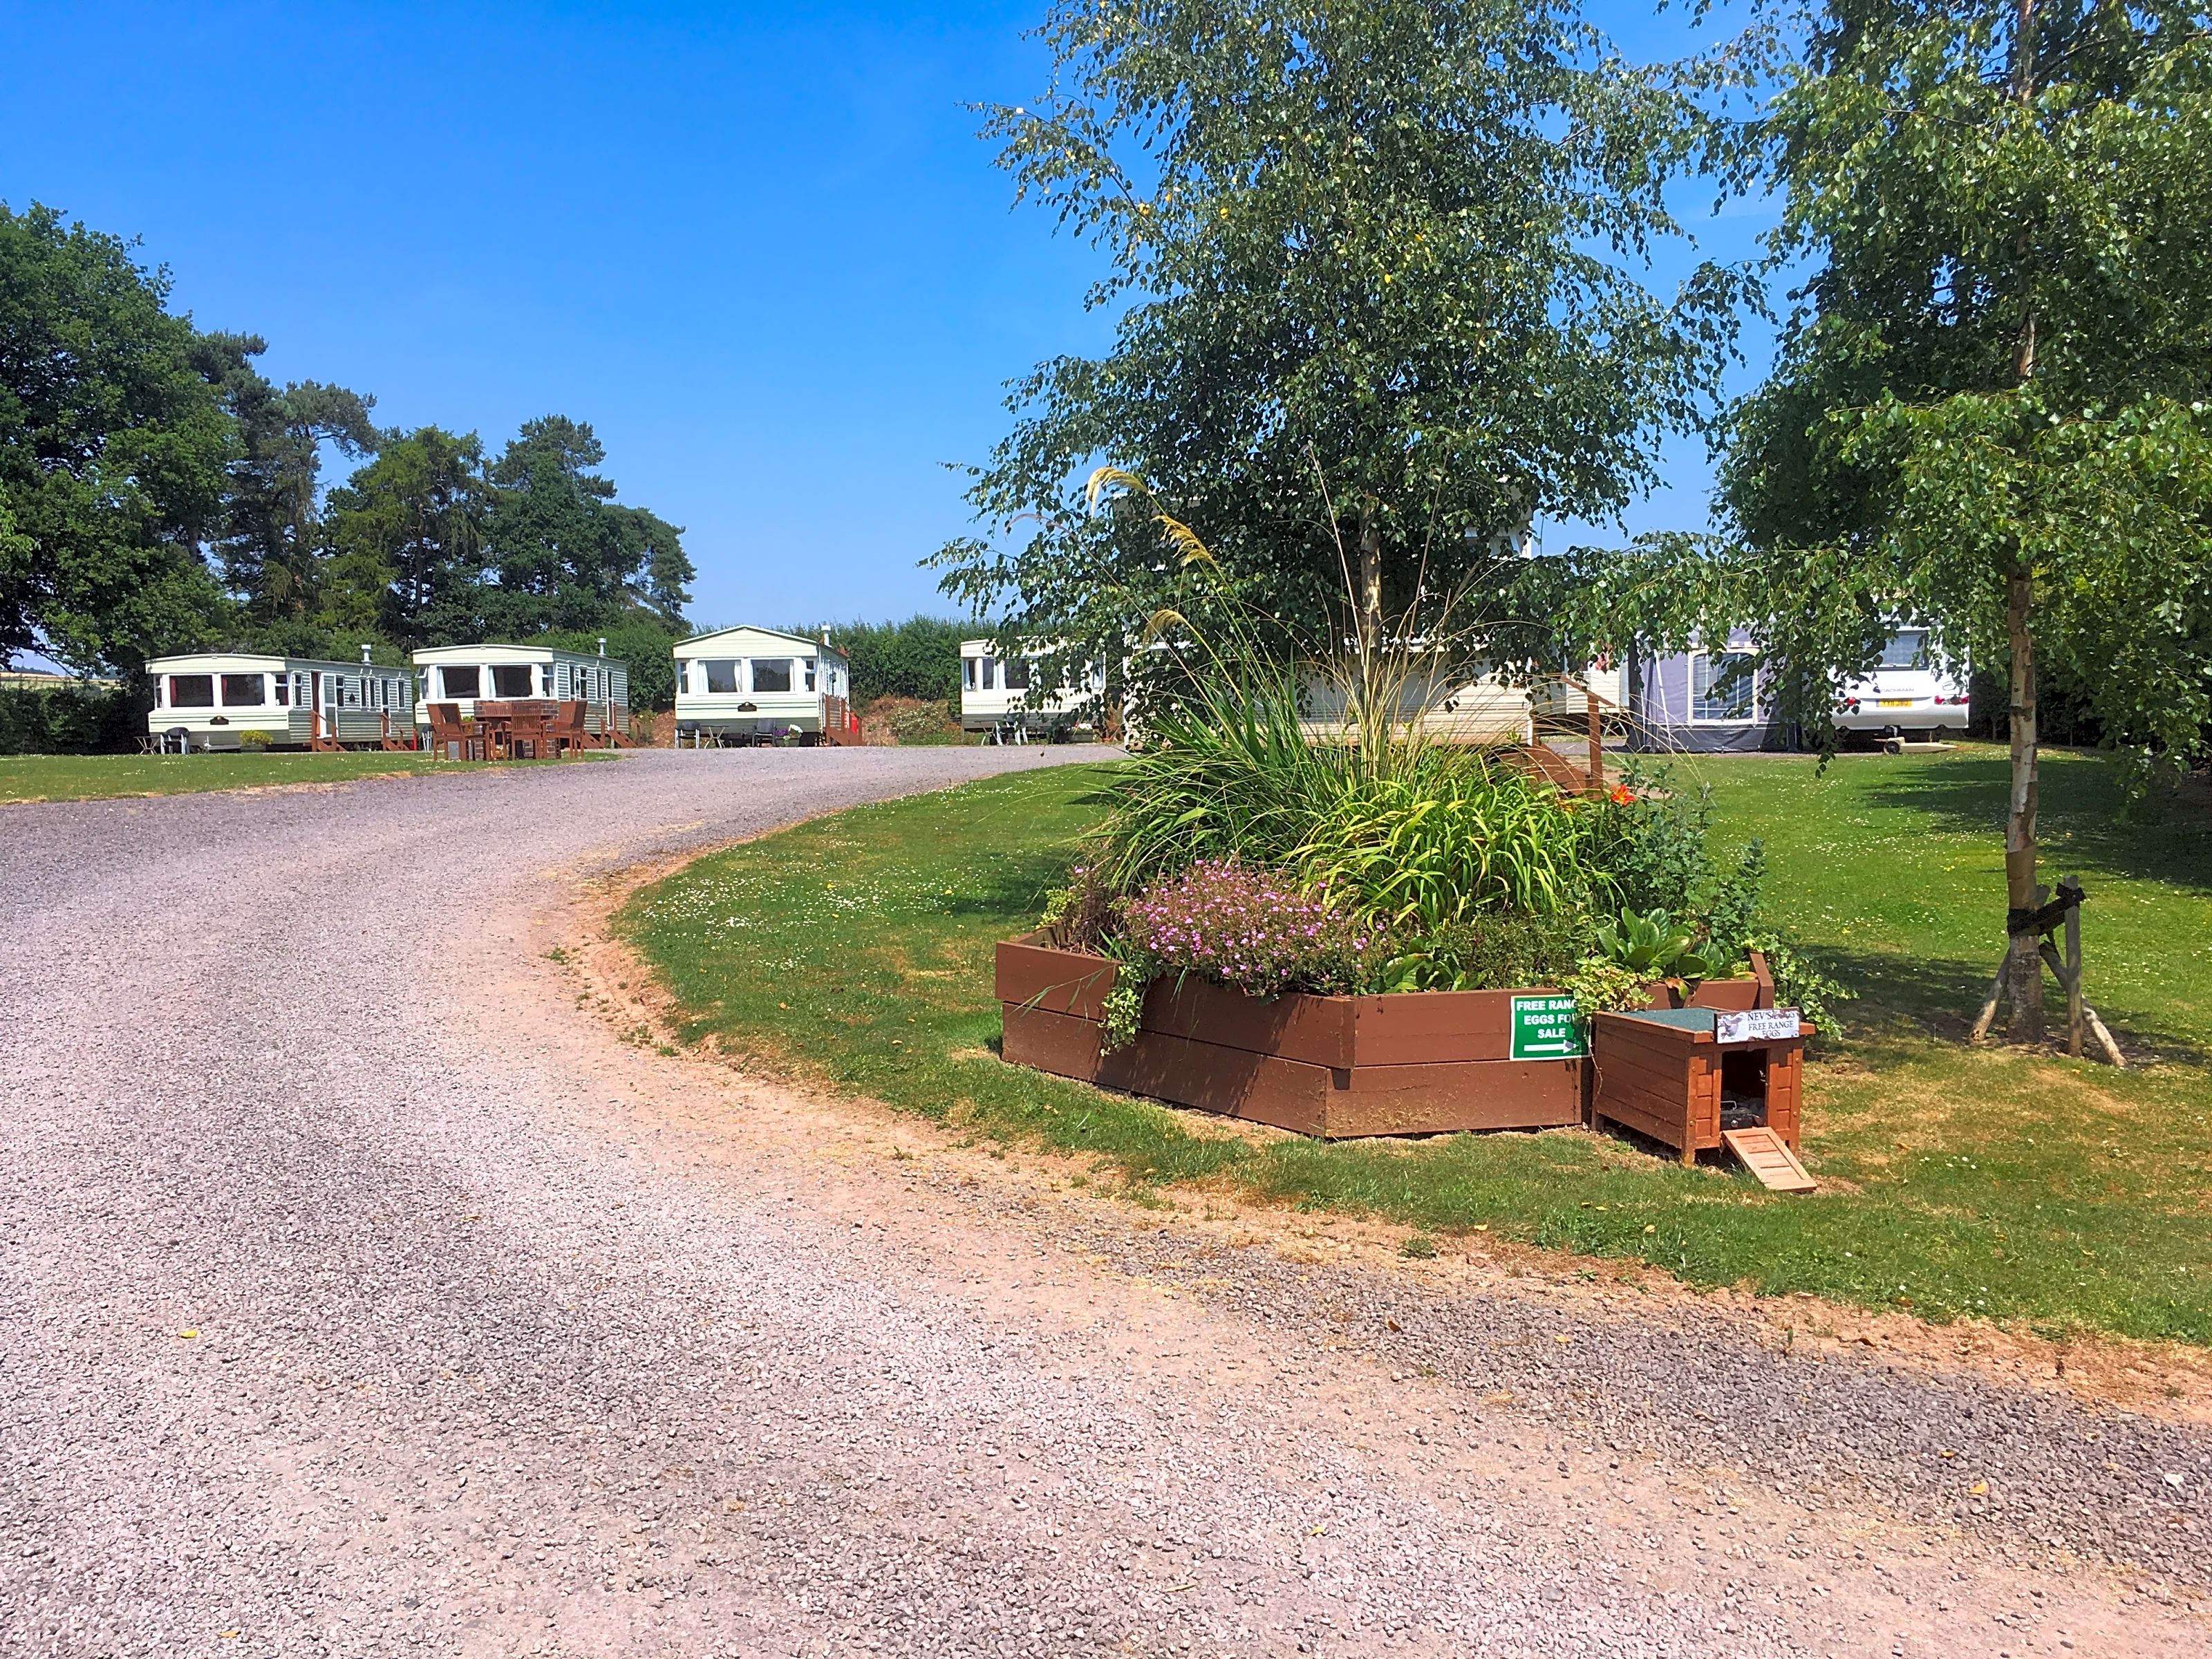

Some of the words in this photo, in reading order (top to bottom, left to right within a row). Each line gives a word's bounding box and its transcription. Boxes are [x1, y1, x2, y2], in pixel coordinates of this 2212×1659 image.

[1517, 1001, 1546, 1011] FREE
[1548, 1000, 1577, 1010] RANG
[1524, 1015, 1555, 1025] EGGS
[1768, 1020, 1794, 1029] RANGE
[1537, 1028, 1566, 1038] SALE
